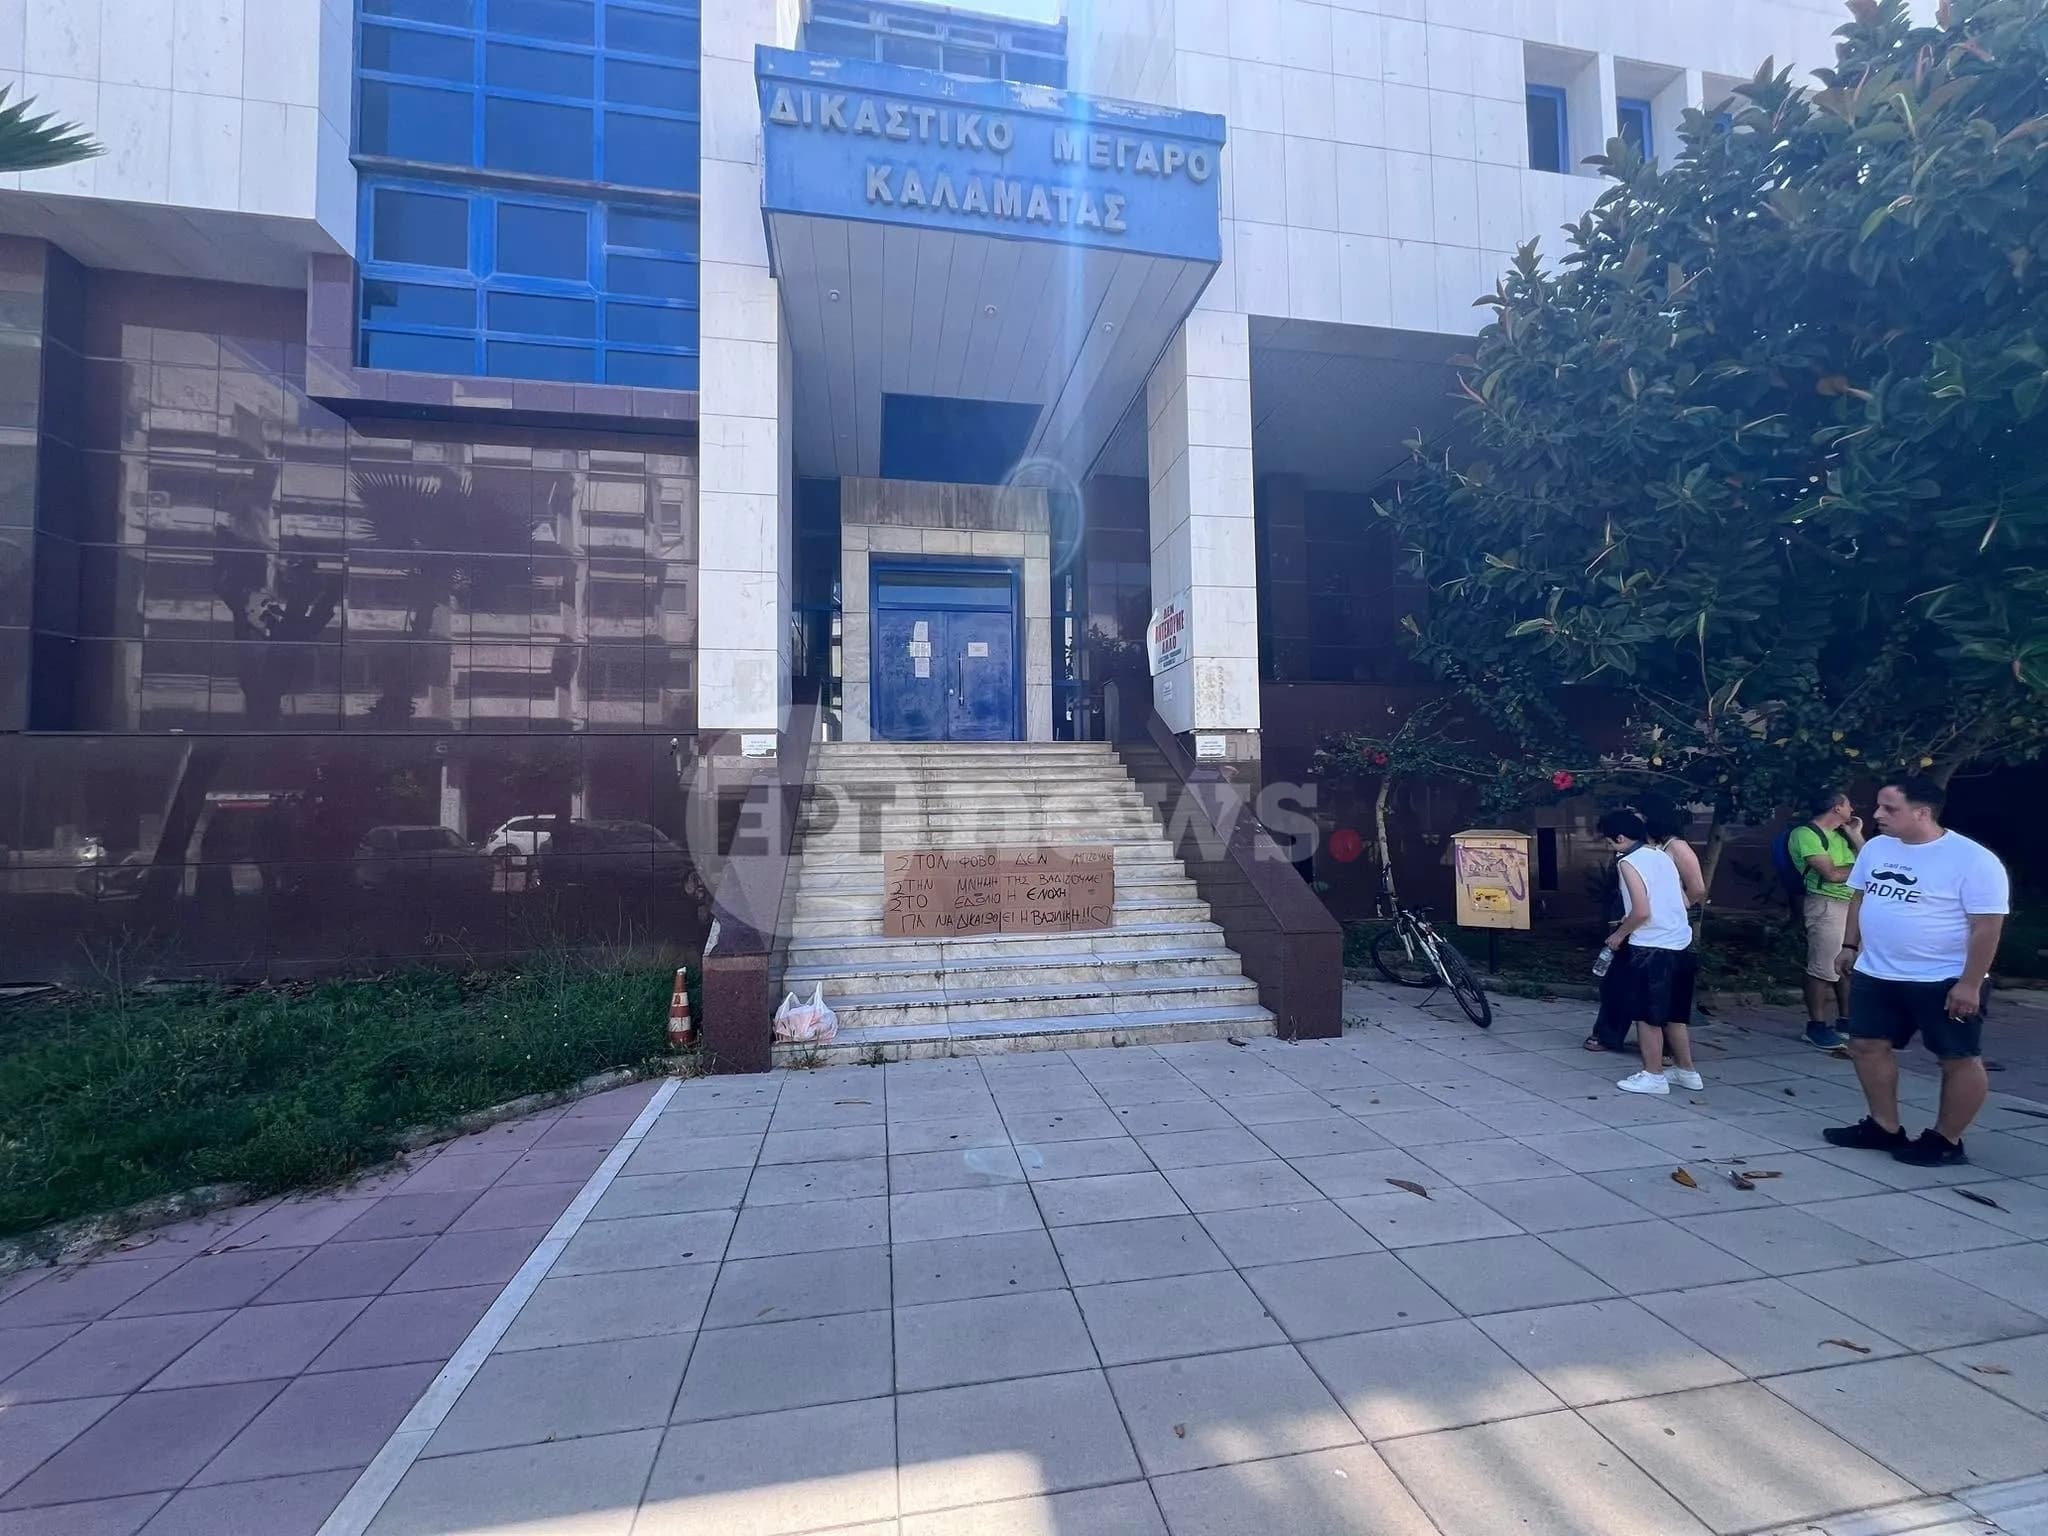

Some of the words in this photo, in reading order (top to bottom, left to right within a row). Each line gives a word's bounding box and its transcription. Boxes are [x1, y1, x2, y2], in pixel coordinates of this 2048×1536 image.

[769, 87, 1014, 153] ΔΙΚΑΣΤΙΚΟ
[1053, 127, 1213, 184] ΜΕΓΑΡΟ
[865, 163, 1128, 232] ΚΑΛΑΜΑΤΑΣ
[893, 853, 950, 871] ΣΤΟΝ
[959, 854, 996, 869] ΦΟΒΟ
[1015, 852, 1048, 866] ΔΕΝ
[889, 878, 934, 896] ΣΤΗΝ
[957, 875, 999, 894] ΜΝΗΜΗ
[1003, 875, 1030, 886] ΤΗΣ
[889, 893, 928, 912] ΣΤΟ
[1007, 887, 1017, 901] Η
[1026, 886, 1067, 901] ΕΝΟΧΗ
[935, 914, 954, 928] ΝΑ
[1020, 909, 1028, 924] Η
